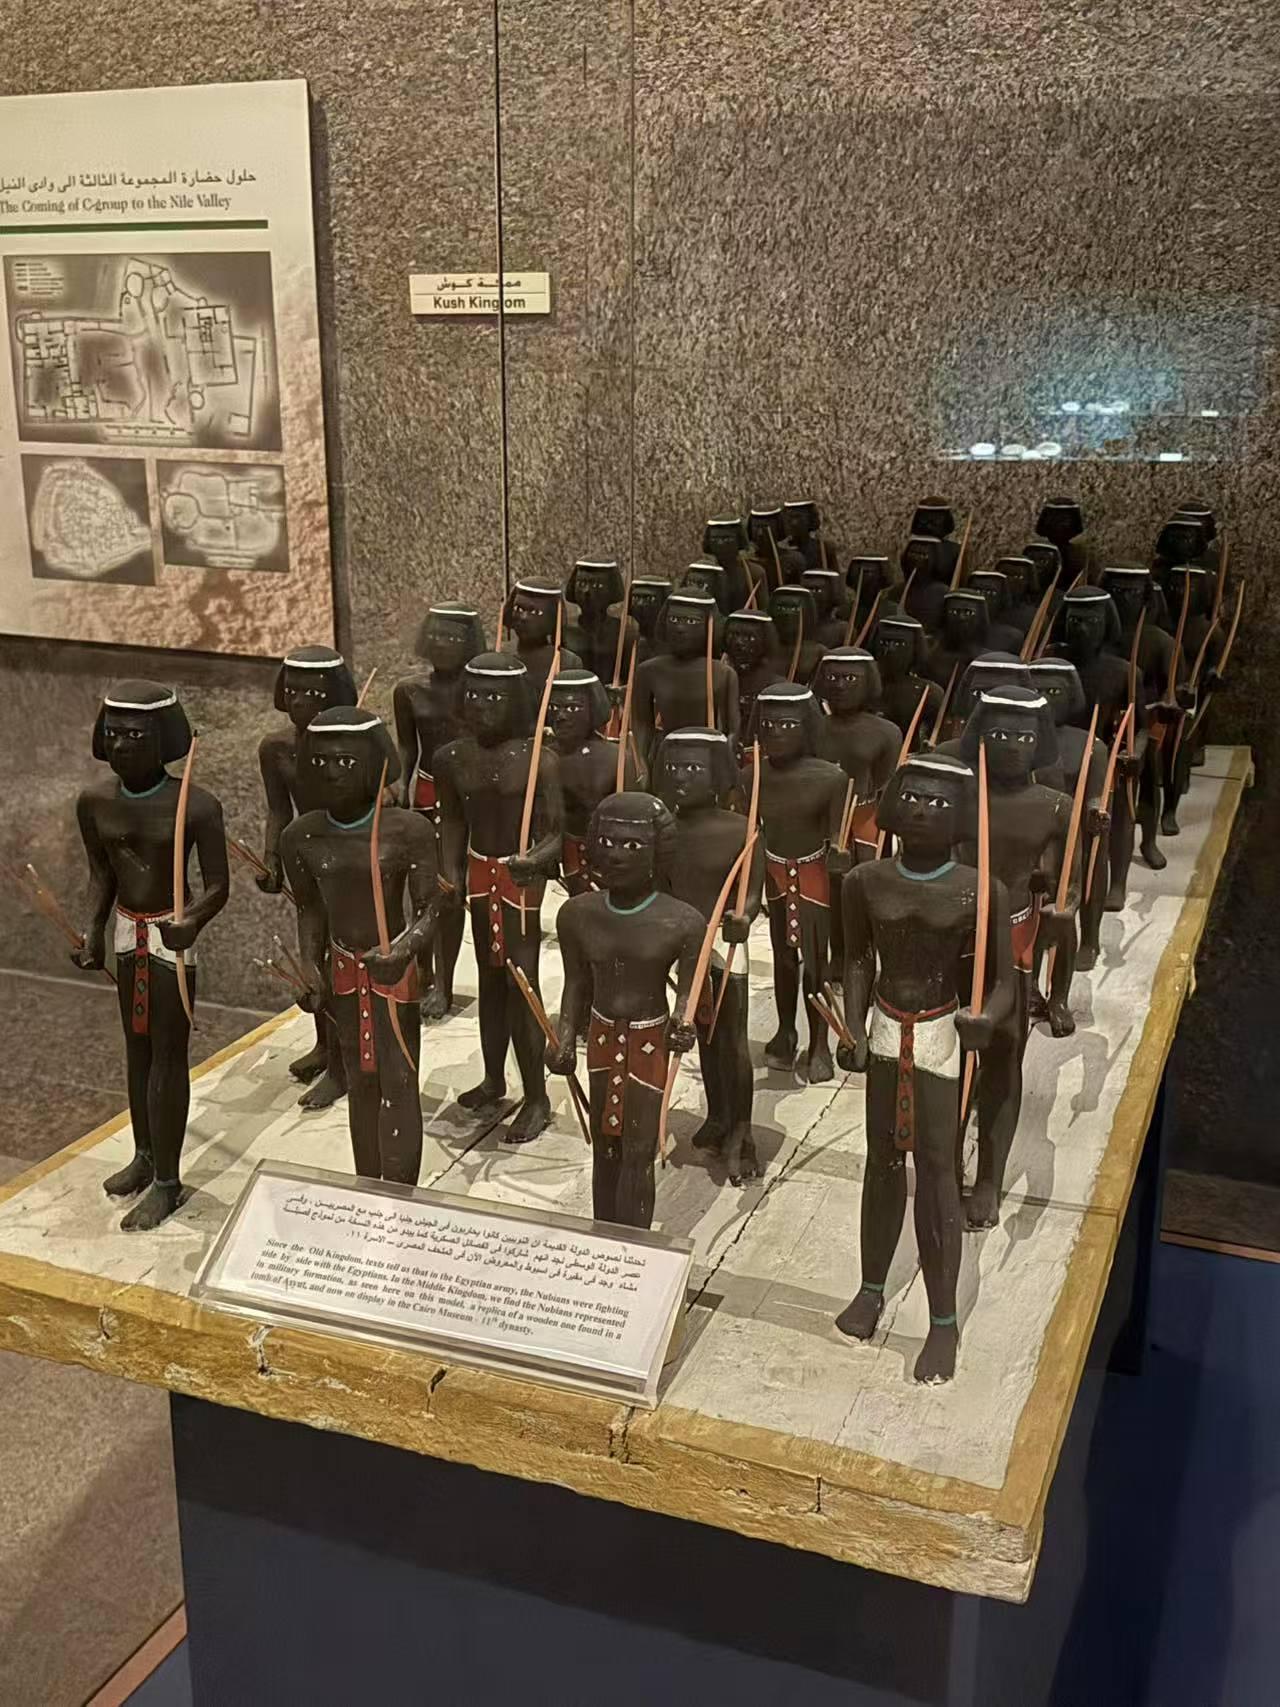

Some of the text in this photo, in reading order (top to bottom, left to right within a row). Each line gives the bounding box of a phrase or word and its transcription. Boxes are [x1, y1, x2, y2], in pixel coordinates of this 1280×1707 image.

[79, 172, 117, 187] الثالثة
[121, 169, 176, 187] المجموعة
[181, 169, 223, 188] حضارة
[227, 168, 256, 186] حلول
[0, 200, 18, 212] The
[22, 199, 65, 214] Coming
[68, 197, 80, 212] of
[132, 196, 144, 210] to
[148, 195, 167, 209] the
[170, 194, 194, 209] Nile
[196, 193, 232, 211] Valley
[437, 276, 473, 291] كوش
[433, 296, 526, 311] Kush Kingom
[354, 1206, 366, 1215] مع
[265, 1238, 288, 1248] Since
[290, 1243, 304, 1251] the
[308, 1246, 324, 1256] Old
[325, 1249, 363, 1264] Kingdom,
[365, 1258, 384, 1268] texts
[385, 1262, 400, 1271] tell
[411, 1266, 428, 1276] that
[439, 1272, 453, 1281] the
[454, 1274, 492, 1289] Egyptian
[492, 1284, 517, 1295] army,
[519, 1288, 534, 1297] the
[536, 1290, 570, 1304] Nubians
[572, 1299, 593, 1309] were
[594, 1302, 629, 1318] fighting
[260, 1249, 277, 1258] side
[279, 1252, 291, 1262] by
[295, 1256, 312, 1265] side
[313, 1260, 331, 1268] with
[332, 1263, 345, 1272] the
[390, 1274, 400, 1282] In
[401, 1277, 415, 1286] the
[416, 1279, 445, 1291] Middle
[447, 1285, 487, 1300] Kingdom,
[489, 1295, 502, 1303] we
[503, 1296, 521, 1306] find
[522, 1300, 536, 1310] the
[536, 1303, 572, 1317] Nubians
[574, 1312, 626, 1327] represented
[250, 1271, 271, 1281] tomb
[272, 1275, 283, 1283] of
[308, 1284, 325, 1292] and
[325, 1287, 343, 1295] now
[356, 1291, 384, 1305] display
[386, 1297, 396, 1306] in
[397, 1300, 411, 1309] the
[412, 1302, 436, 1314] Cairo
[437, 1307, 473, 1322] Museum
[498, 1320, 533, 1335] dynasty.
[255, 1259, 264, 1268] in
[267, 1263, 300, 1275] military
[303, 1269, 343, 1284] formation,
[360, 1282, 378, 1290] seen
[381, 1284, 400, 1295] here
[403, 1290, 414, 1298] on
[418, 1292, 434, 1301] this
[477, 1303, 506, 1316] replica
[507, 1309, 518, 1319] of
[518, 1312, 524, 1320] a
[526, 1315, 558, 1326] wooden
[559, 1321, 576, 1330] one
[577, 1323, 603, 1336] found
[604, 1328, 614, 1338] in
